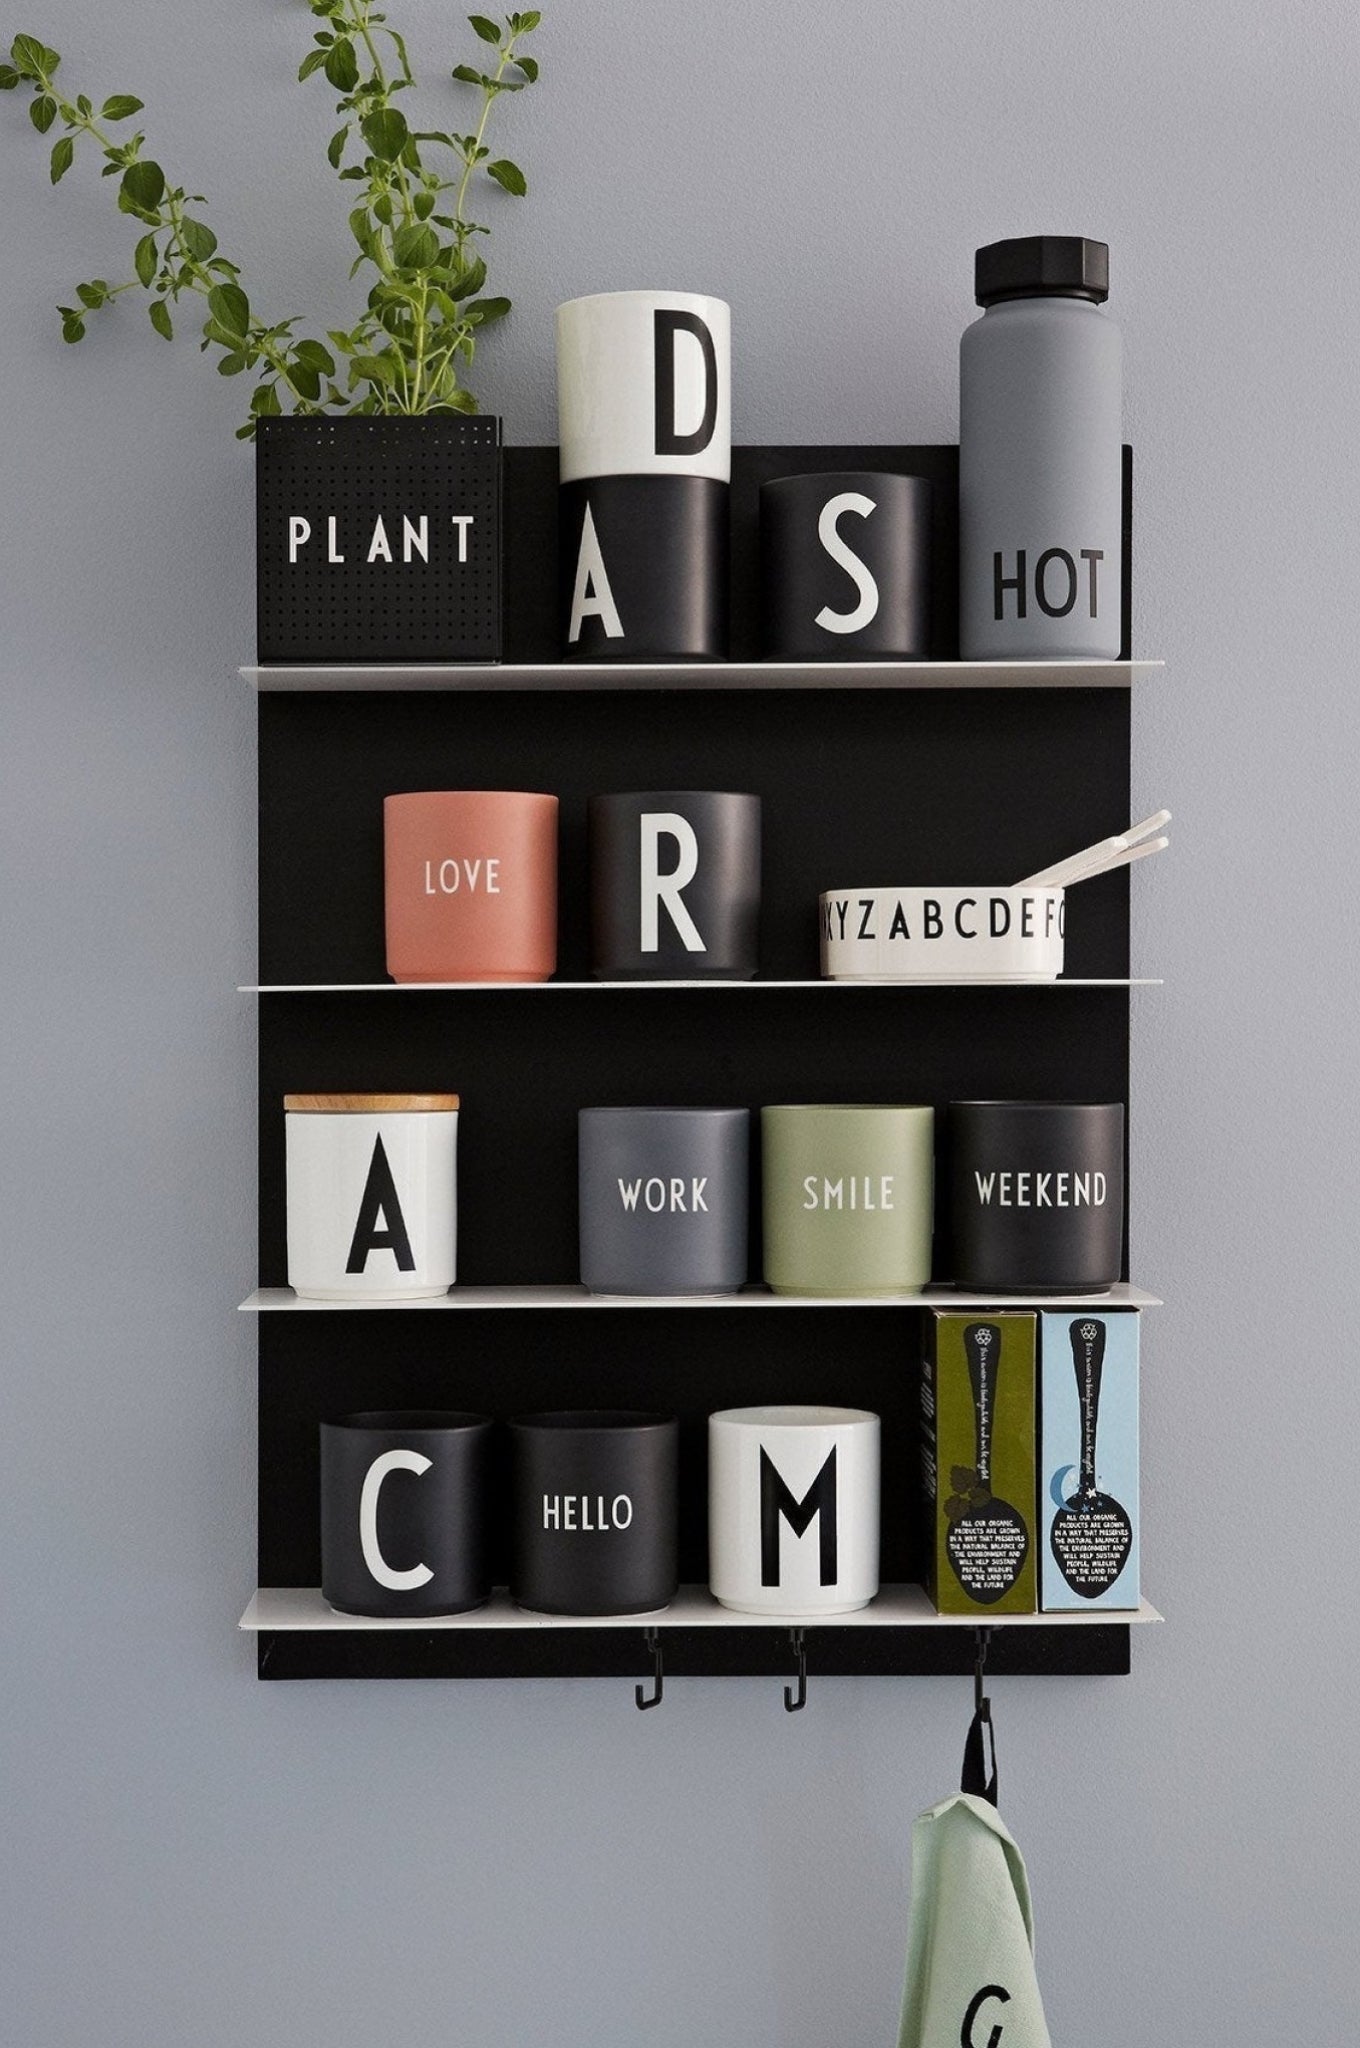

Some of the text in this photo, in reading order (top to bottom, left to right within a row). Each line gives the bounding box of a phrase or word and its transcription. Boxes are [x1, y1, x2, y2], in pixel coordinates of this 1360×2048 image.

[653, 308, 719, 457] D
[288, 513, 475, 564] PLANT
[567, 499, 626, 644] A
[813, 491, 880, 635] S
[993, 547, 1104, 621] HOT
[425, 858, 501, 895] LOVE
[640, 812, 708, 952] R
[345, 1130, 417, 1275] A
[617, 1177, 709, 1213] WORK
[803, 1175, 895, 1211] SMILE
[974, 1170, 1107, 1208] WEEKEND
[359, 1448, 436, 1591] C
[542, 1493, 634, 1531] HELLO
[759, 1443, 838, 1588] M
